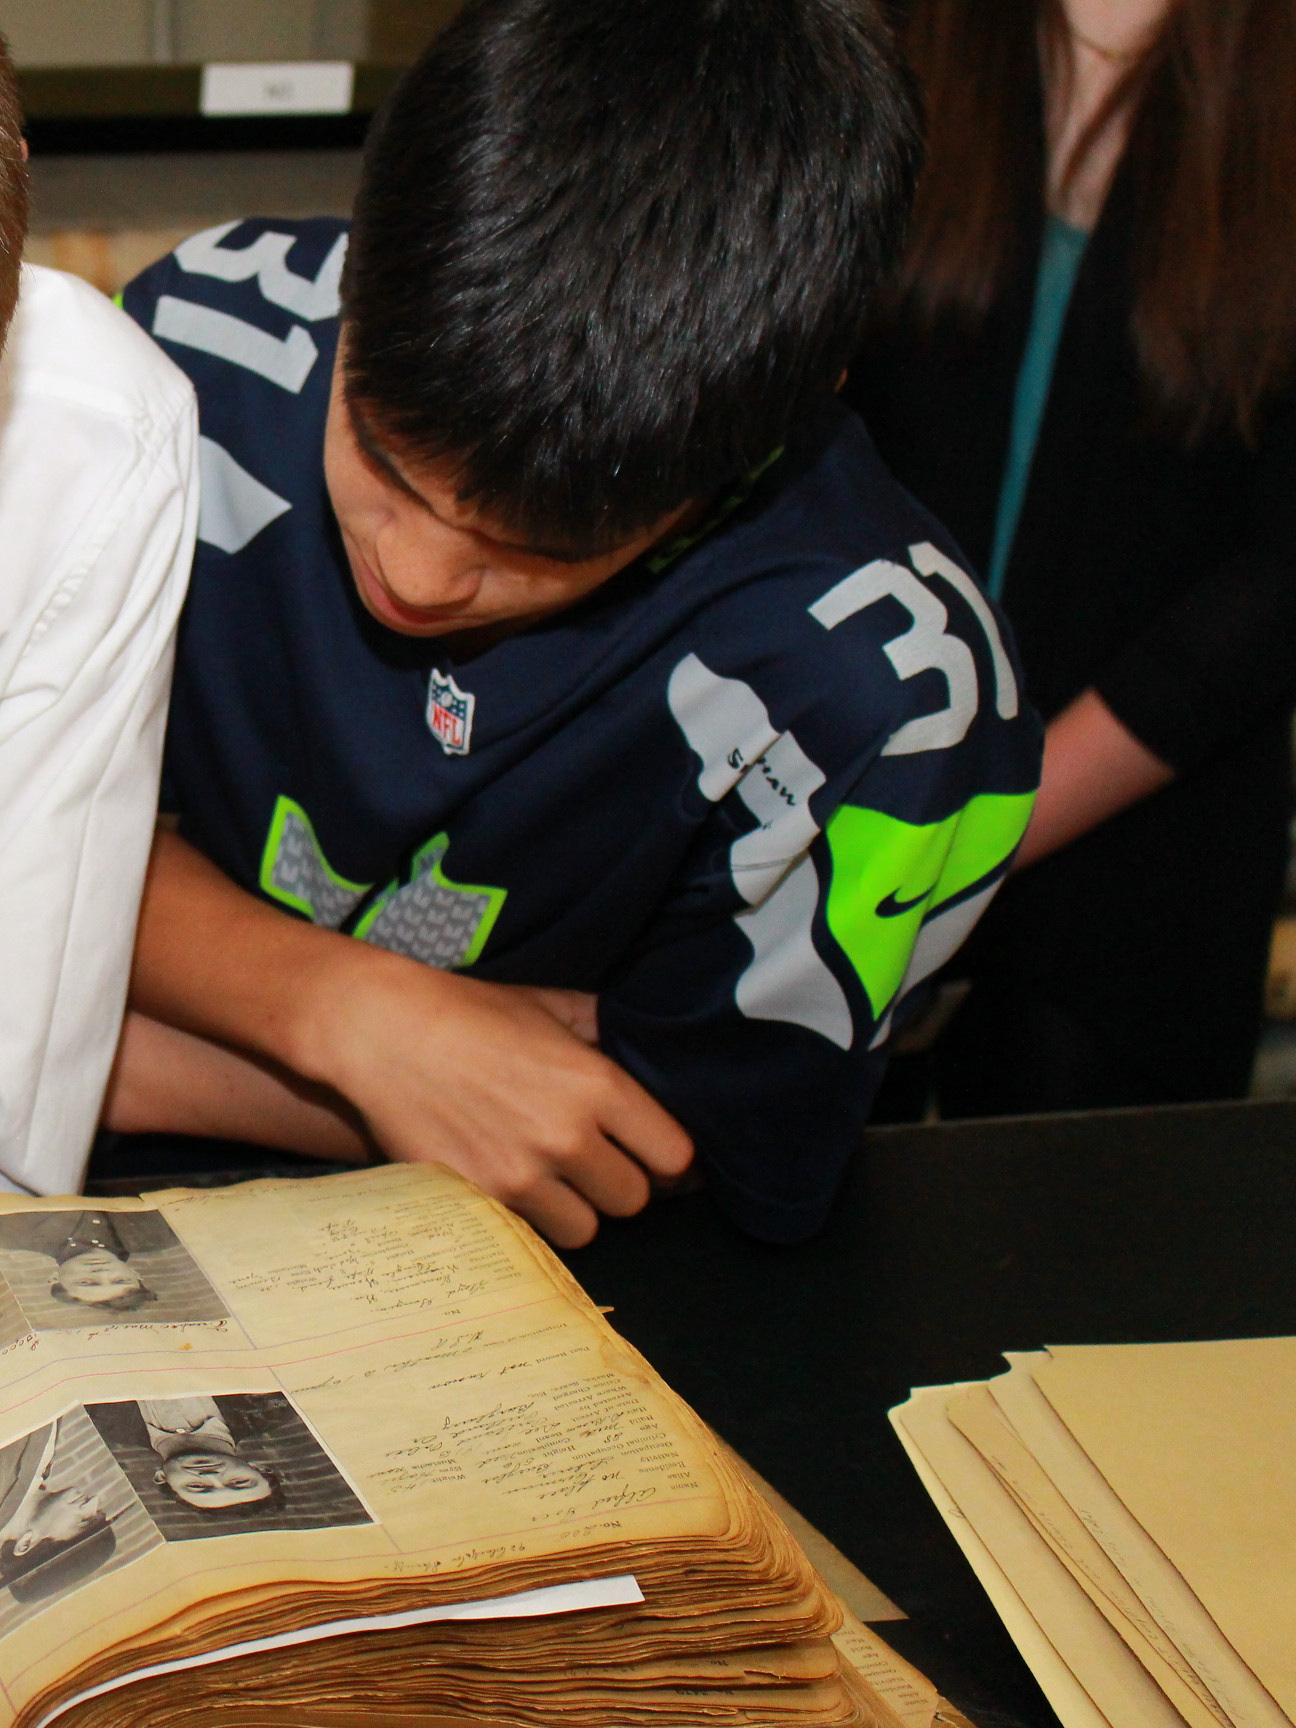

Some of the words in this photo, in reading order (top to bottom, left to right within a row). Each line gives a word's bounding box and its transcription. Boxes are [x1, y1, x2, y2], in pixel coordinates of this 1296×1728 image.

[152, 219, 349, 395] 31
[807, 540, 1019, 757] 31
[433, 703, 461, 745] NFL
[411, 1247, 457, 1263] Occupation
[453, 1243, 500, 1259] Occupation
[568, 1346, 590, 1355] Past
[535, 1351, 567, 1363] Record
[582, 1372, 615, 1383] Marks,
[593, 1379, 621, 1389] Crime
[527, 1391, 547, 1399] Etc.
[552, 1385, 591, 1401] Charged
[596, 1385, 626, 1396] Where
[554, 1395, 594, 1412] Arrested
[592, 1392, 633, 1405] Arrested
[615, 1398, 639, 1407] Date
[579, 1403, 591, 1412] by
[627, 1406, 648, 1415] Hair
[570, 1409, 600, 1422] Arrest
[629, 1414, 654, 1424] Build
[640, 1422, 659, 1432] Age
[535, 1431, 563, 1443] Beard
[626, 1432, 666, 1448] Criminal
[516, 1438, 570, 1455] Complexion
[543, 1444, 576, 1458] Height
[572, 1444, 624, 1460] Occupation
[621, 1441, 673, 1457] Occupation
[640, 1451, 679, 1464] Nativity
[411, 1458, 455, 1470] Mustache
[439, 1465, 463, 1473] Eyes
[638, 1461, 685, 1473] Residence
[432, 1474, 466, 1483] Weight
[667, 1472, 691, 1481] Alias
[670, 1482, 698, 1490] Name
[591, 1483, 656, 1510] Alfred
[599, 1520, 622, 1529] No.
